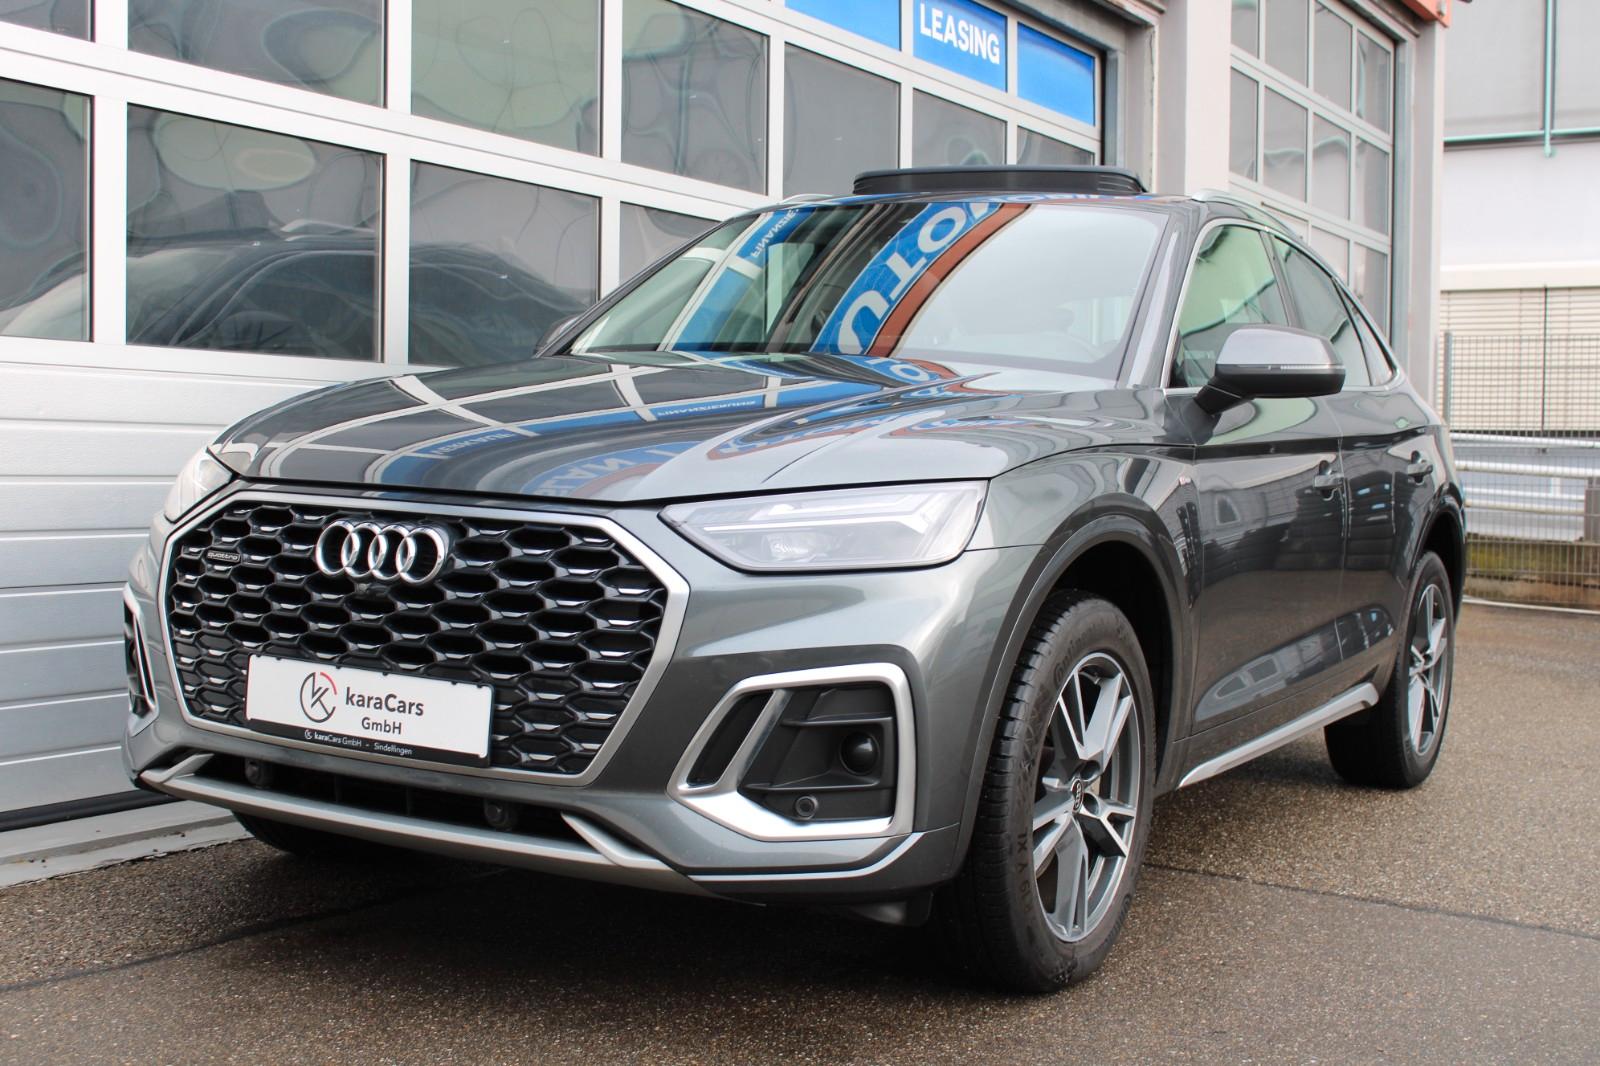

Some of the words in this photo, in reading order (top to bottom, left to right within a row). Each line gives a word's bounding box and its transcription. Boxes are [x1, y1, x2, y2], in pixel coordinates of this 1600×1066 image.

[919, 3, 1000, 65] LEASING
[207, 552, 238, 561] quattro
[345, 686, 424, 717] karaCars
[361, 716, 402, 735] GmbH
[314, 732, 341, 744] karaCars
[342, 737, 362, 747] GmbH
